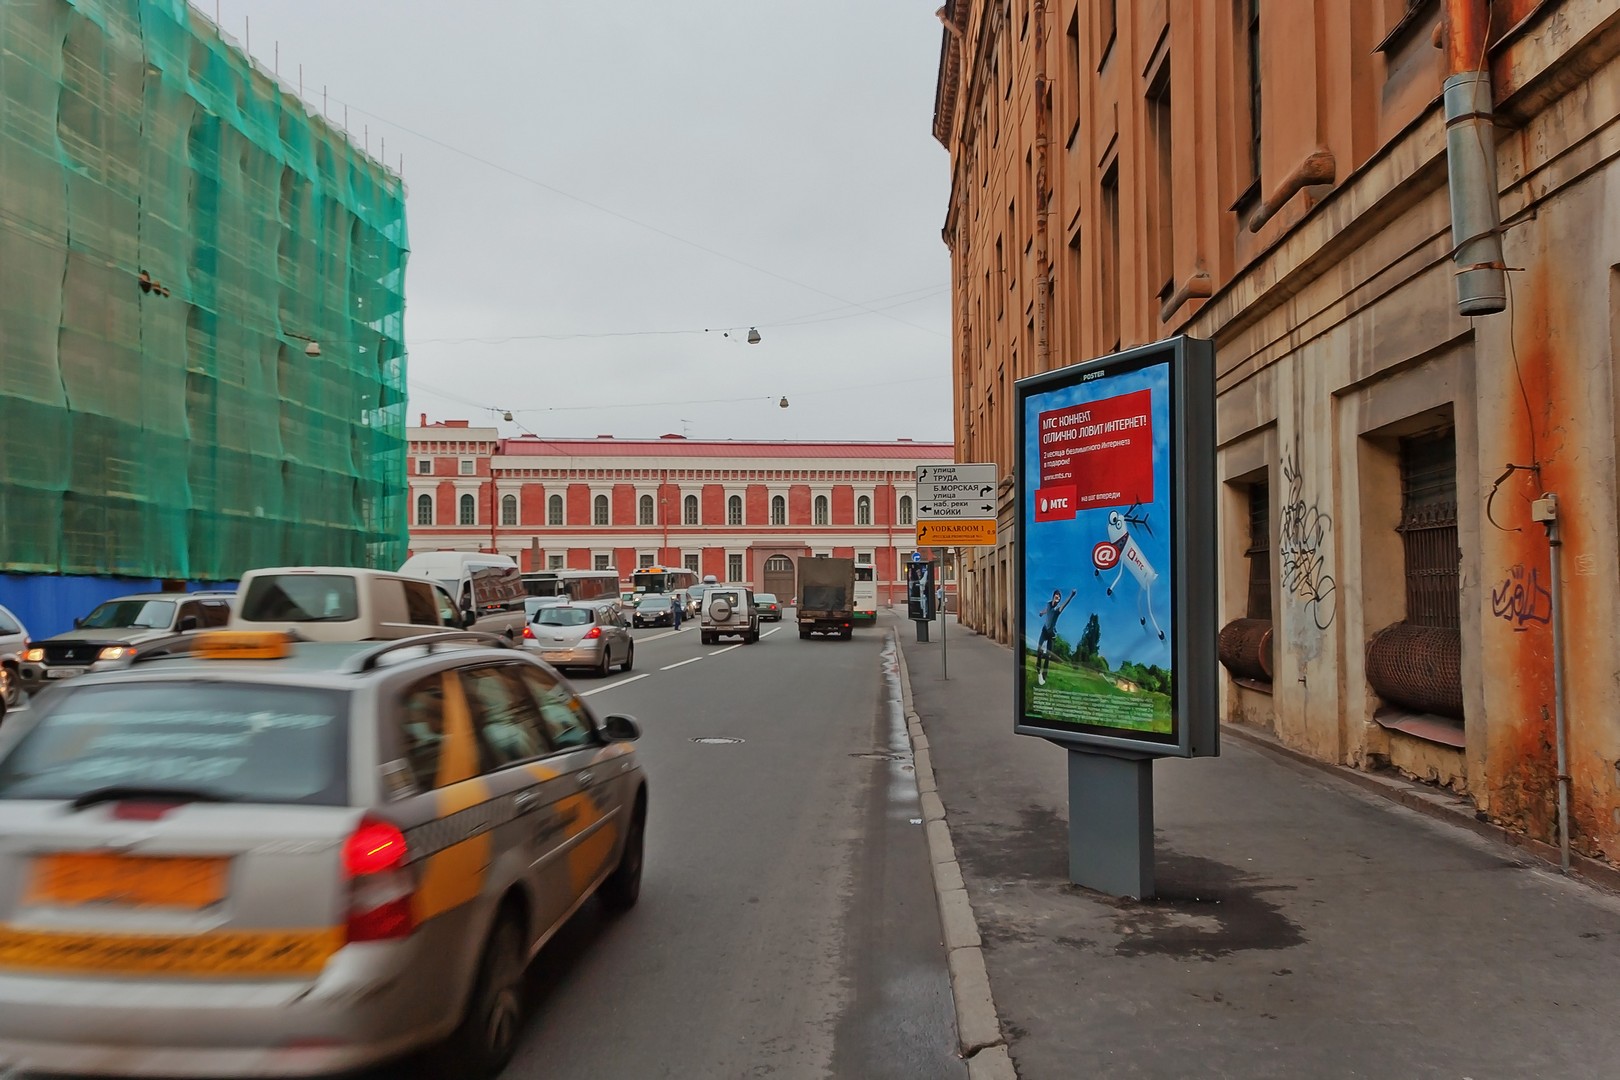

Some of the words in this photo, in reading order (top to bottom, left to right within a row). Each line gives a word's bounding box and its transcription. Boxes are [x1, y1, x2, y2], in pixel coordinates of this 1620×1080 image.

[1083, 370, 1105, 380] POSTER
[1043, 417, 1058, 430] МТС
[1059, 410, 1091, 427] КОННЕКТ
[1043, 428, 1077, 444] ОТЛИЧНО
[1078, 423, 1104, 438] ЛОВИТ
[1104, 414, 1146, 432] ИНТЕРНЕТ!
[1043, 451, 1047, 459] 2
[933, 474, 958, 482] ТРУДА
[933, 484, 979, 492] Б.МОРСКАЯ
[1050, 498, 1068, 509] МТС
[933, 508, 961, 516] МОЙКИ
